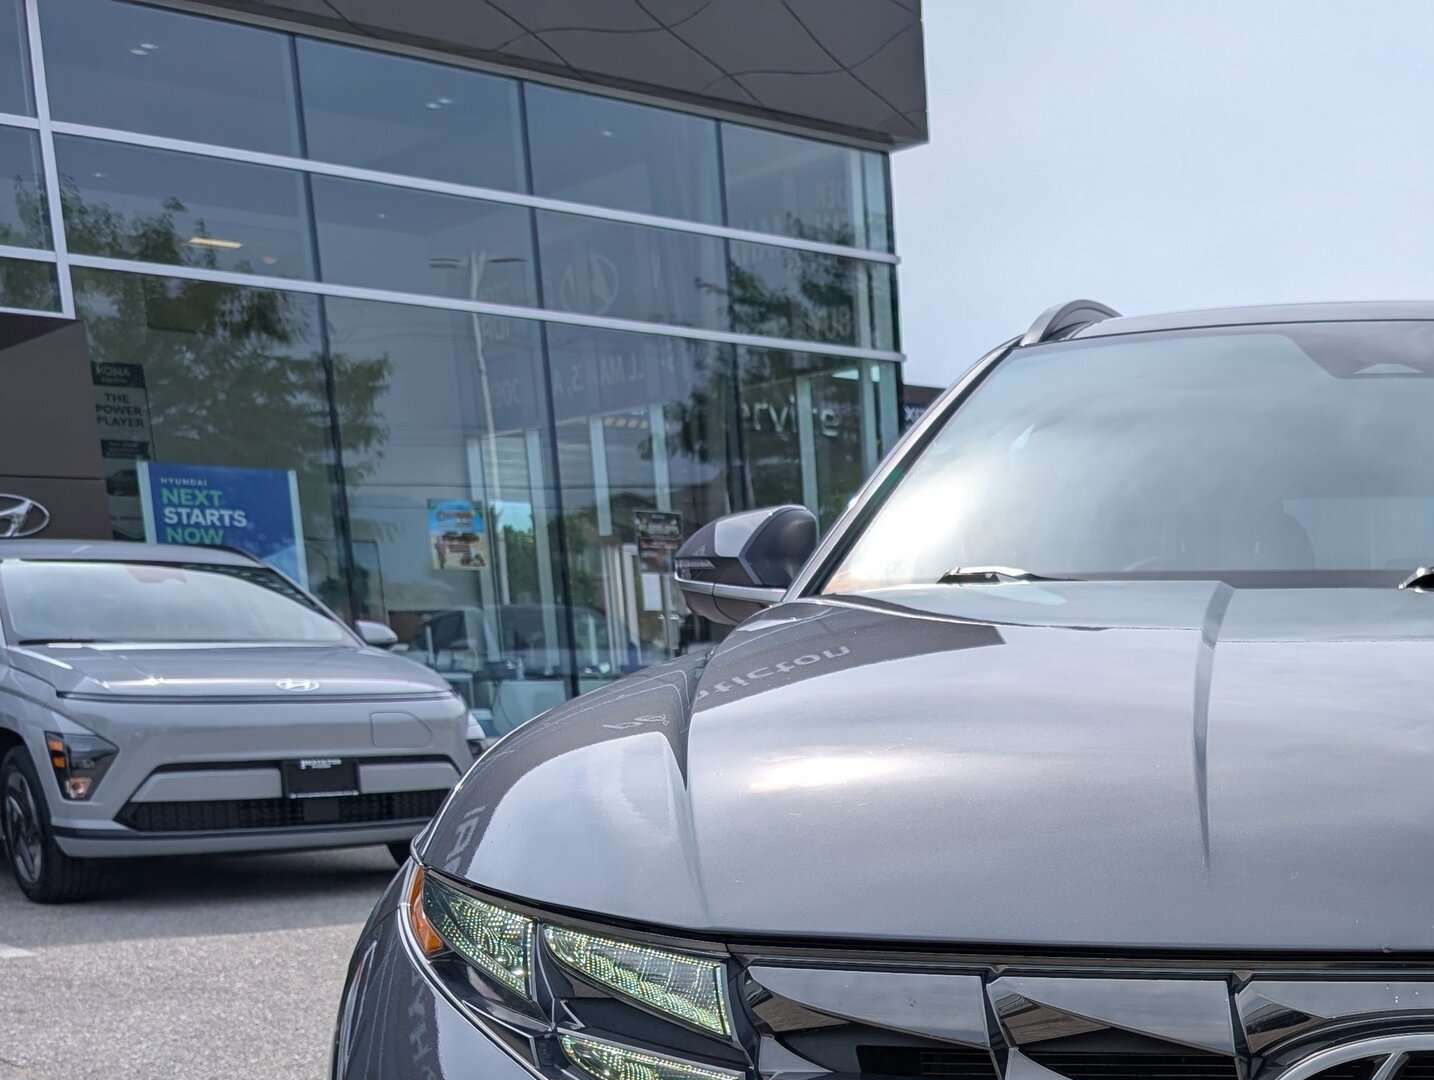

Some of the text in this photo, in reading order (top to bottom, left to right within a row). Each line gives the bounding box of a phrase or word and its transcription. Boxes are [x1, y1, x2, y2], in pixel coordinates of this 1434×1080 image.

[104, 393, 128, 403] THE
[97, 416, 144, 428] PLAYER
[160, 477, 207, 487] HYUNDAI
[161, 487, 223, 507] NEXT
[163, 507, 248, 528] STARTS
[166, 527, 224, 544] NOW
